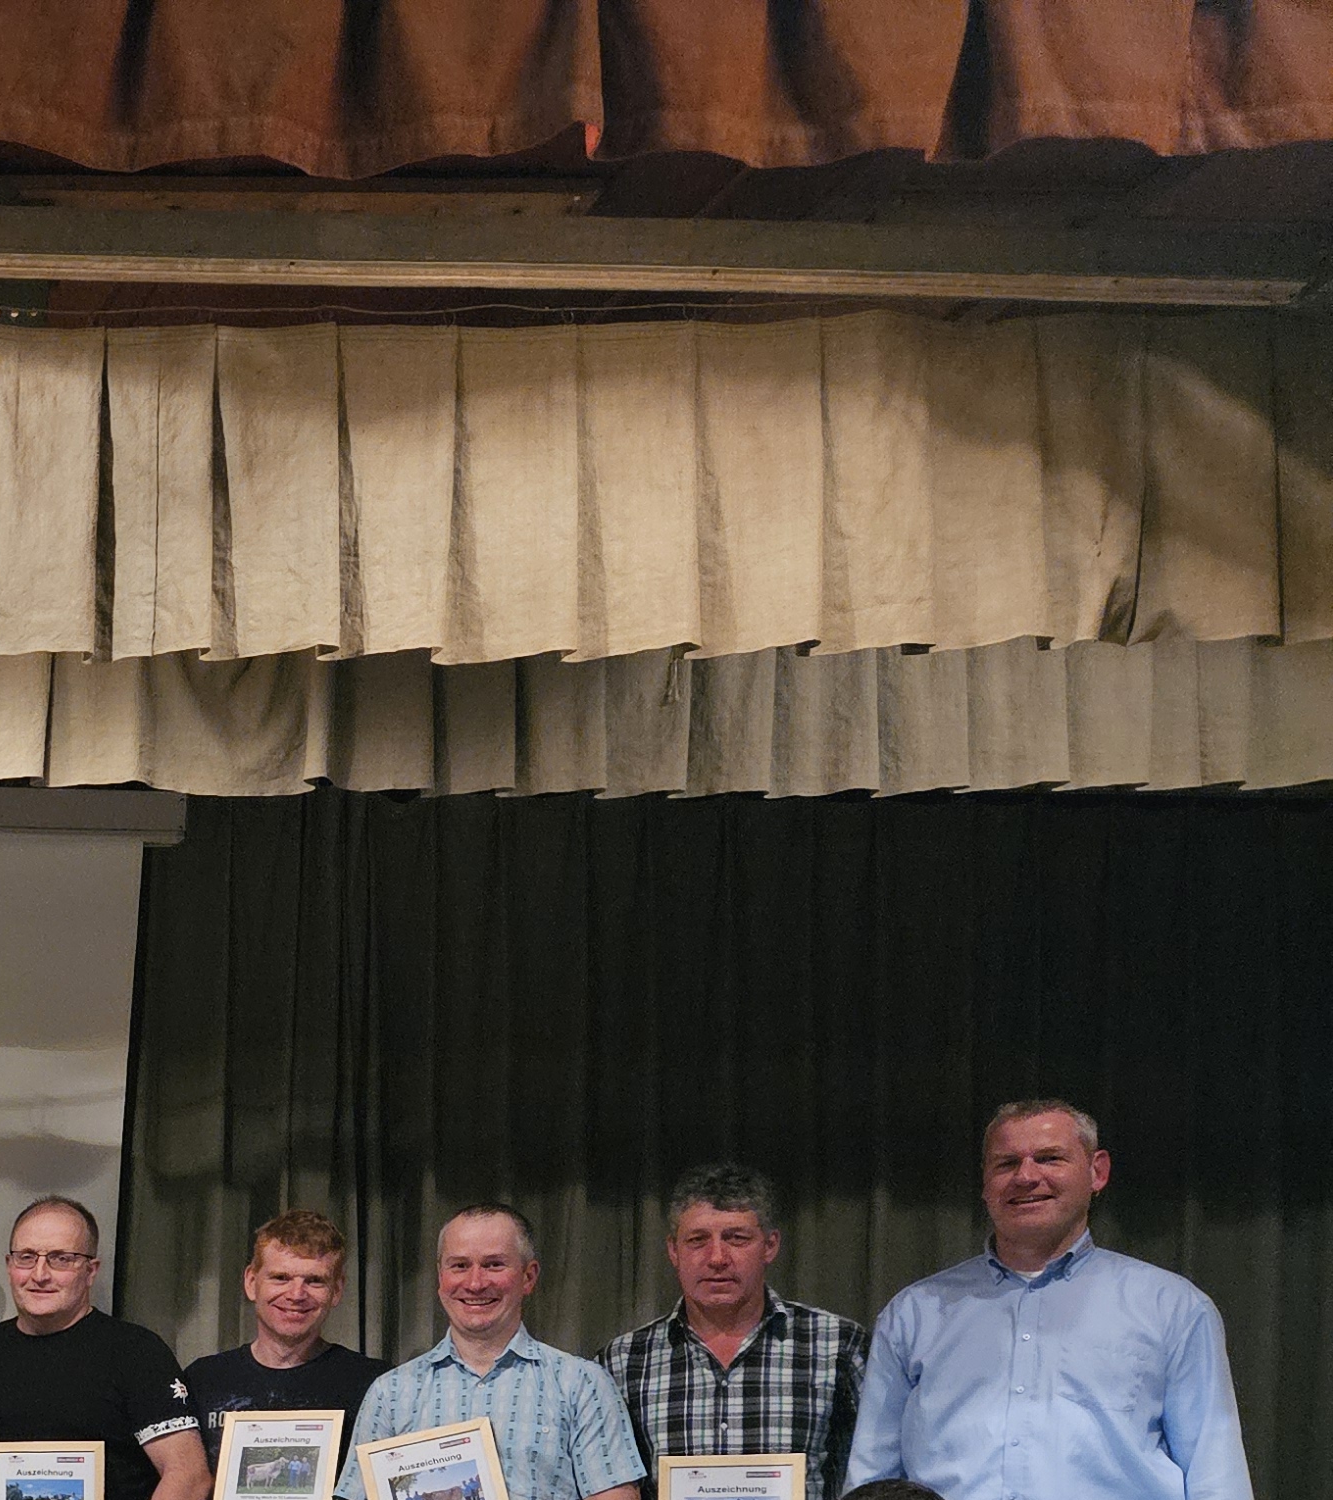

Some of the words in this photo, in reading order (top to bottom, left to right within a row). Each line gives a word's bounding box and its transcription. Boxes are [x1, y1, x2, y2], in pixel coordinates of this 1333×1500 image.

[398, 1453, 462, 1472] Auszeichnung
[16, 1469, 73, 1477] Auszeichnung
[697, 1486, 767, 1494] Auszeichnung
